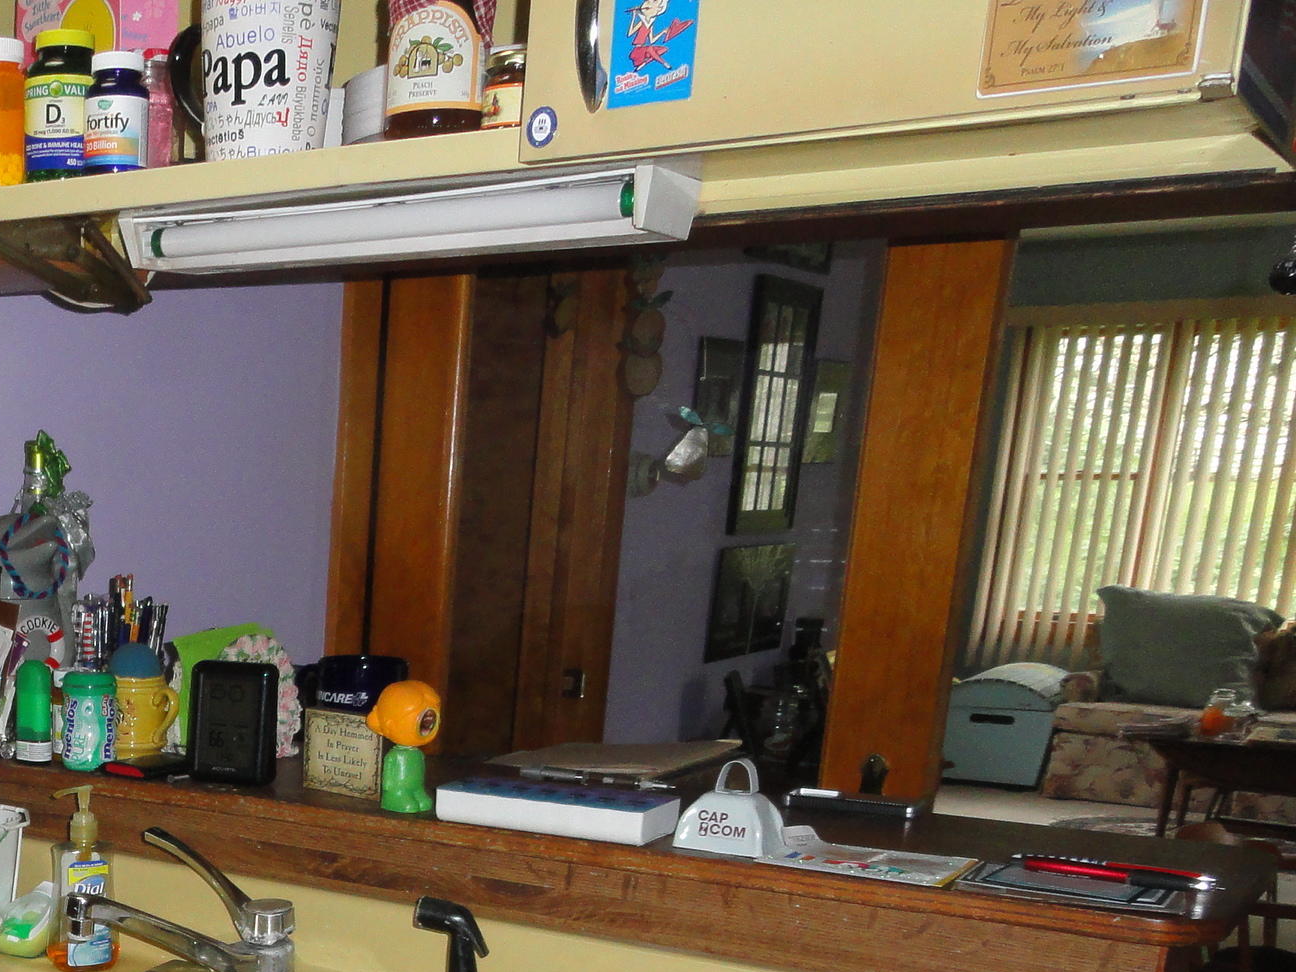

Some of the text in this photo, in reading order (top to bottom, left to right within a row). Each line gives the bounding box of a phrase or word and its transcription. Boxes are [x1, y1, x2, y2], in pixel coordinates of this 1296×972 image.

[1012, 6, 1045, 33] My
[216, 26, 275, 50] Abuelo
[1000, 32, 1113, 67] My Salvation
[296, 35, 313, 83] Дядо
[203, 49, 291, 106] Papa
[412, 81, 434, 90] PEACH
[408, 89, 437, 99] PRESERVE
[87, 112, 129, 133] fortify
[93, 140, 117, 151] Billion
[20, 617, 57, 635] COOKIE
[63, 699, 78, 760] mentos
[340, 728, 373, 741] Hemmed
[327, 739, 334, 748] In
[318, 751, 368, 768] Is Less Likely
[323, 765, 362, 780] To Unravel
[698, 810, 729, 823] CAP
[74, 882, 104, 895] Dial
